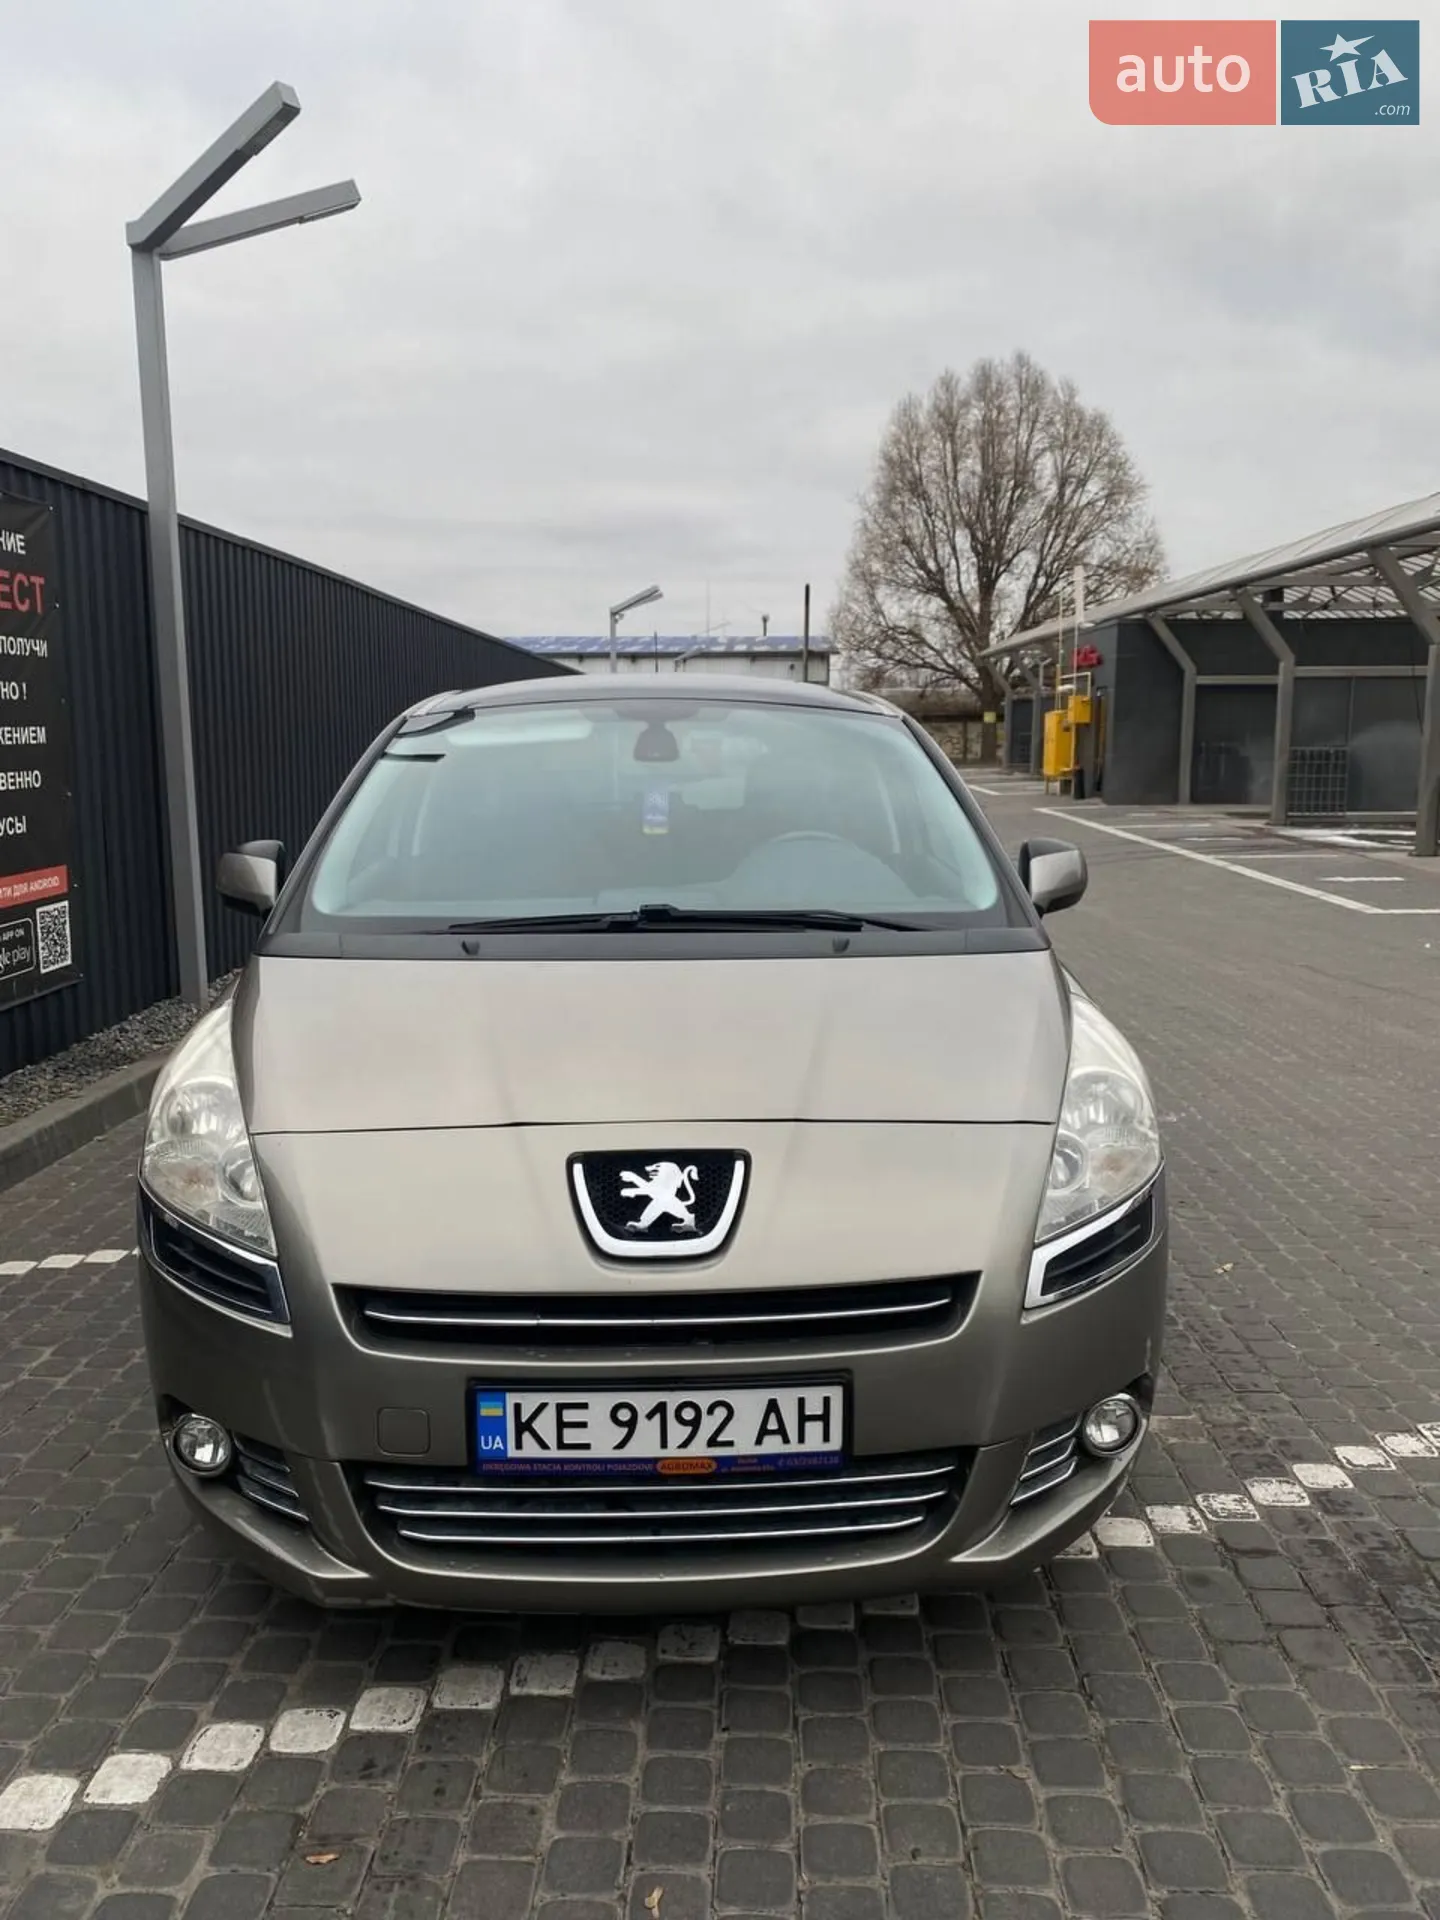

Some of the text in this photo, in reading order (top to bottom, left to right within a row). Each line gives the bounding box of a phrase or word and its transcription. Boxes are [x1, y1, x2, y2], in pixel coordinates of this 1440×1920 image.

[0, 635, 48, 660] ПОЛУЧИ
[514, 1396, 832, 1450] KE 9192 AH
[480, 1434, 504, 1450] UA
